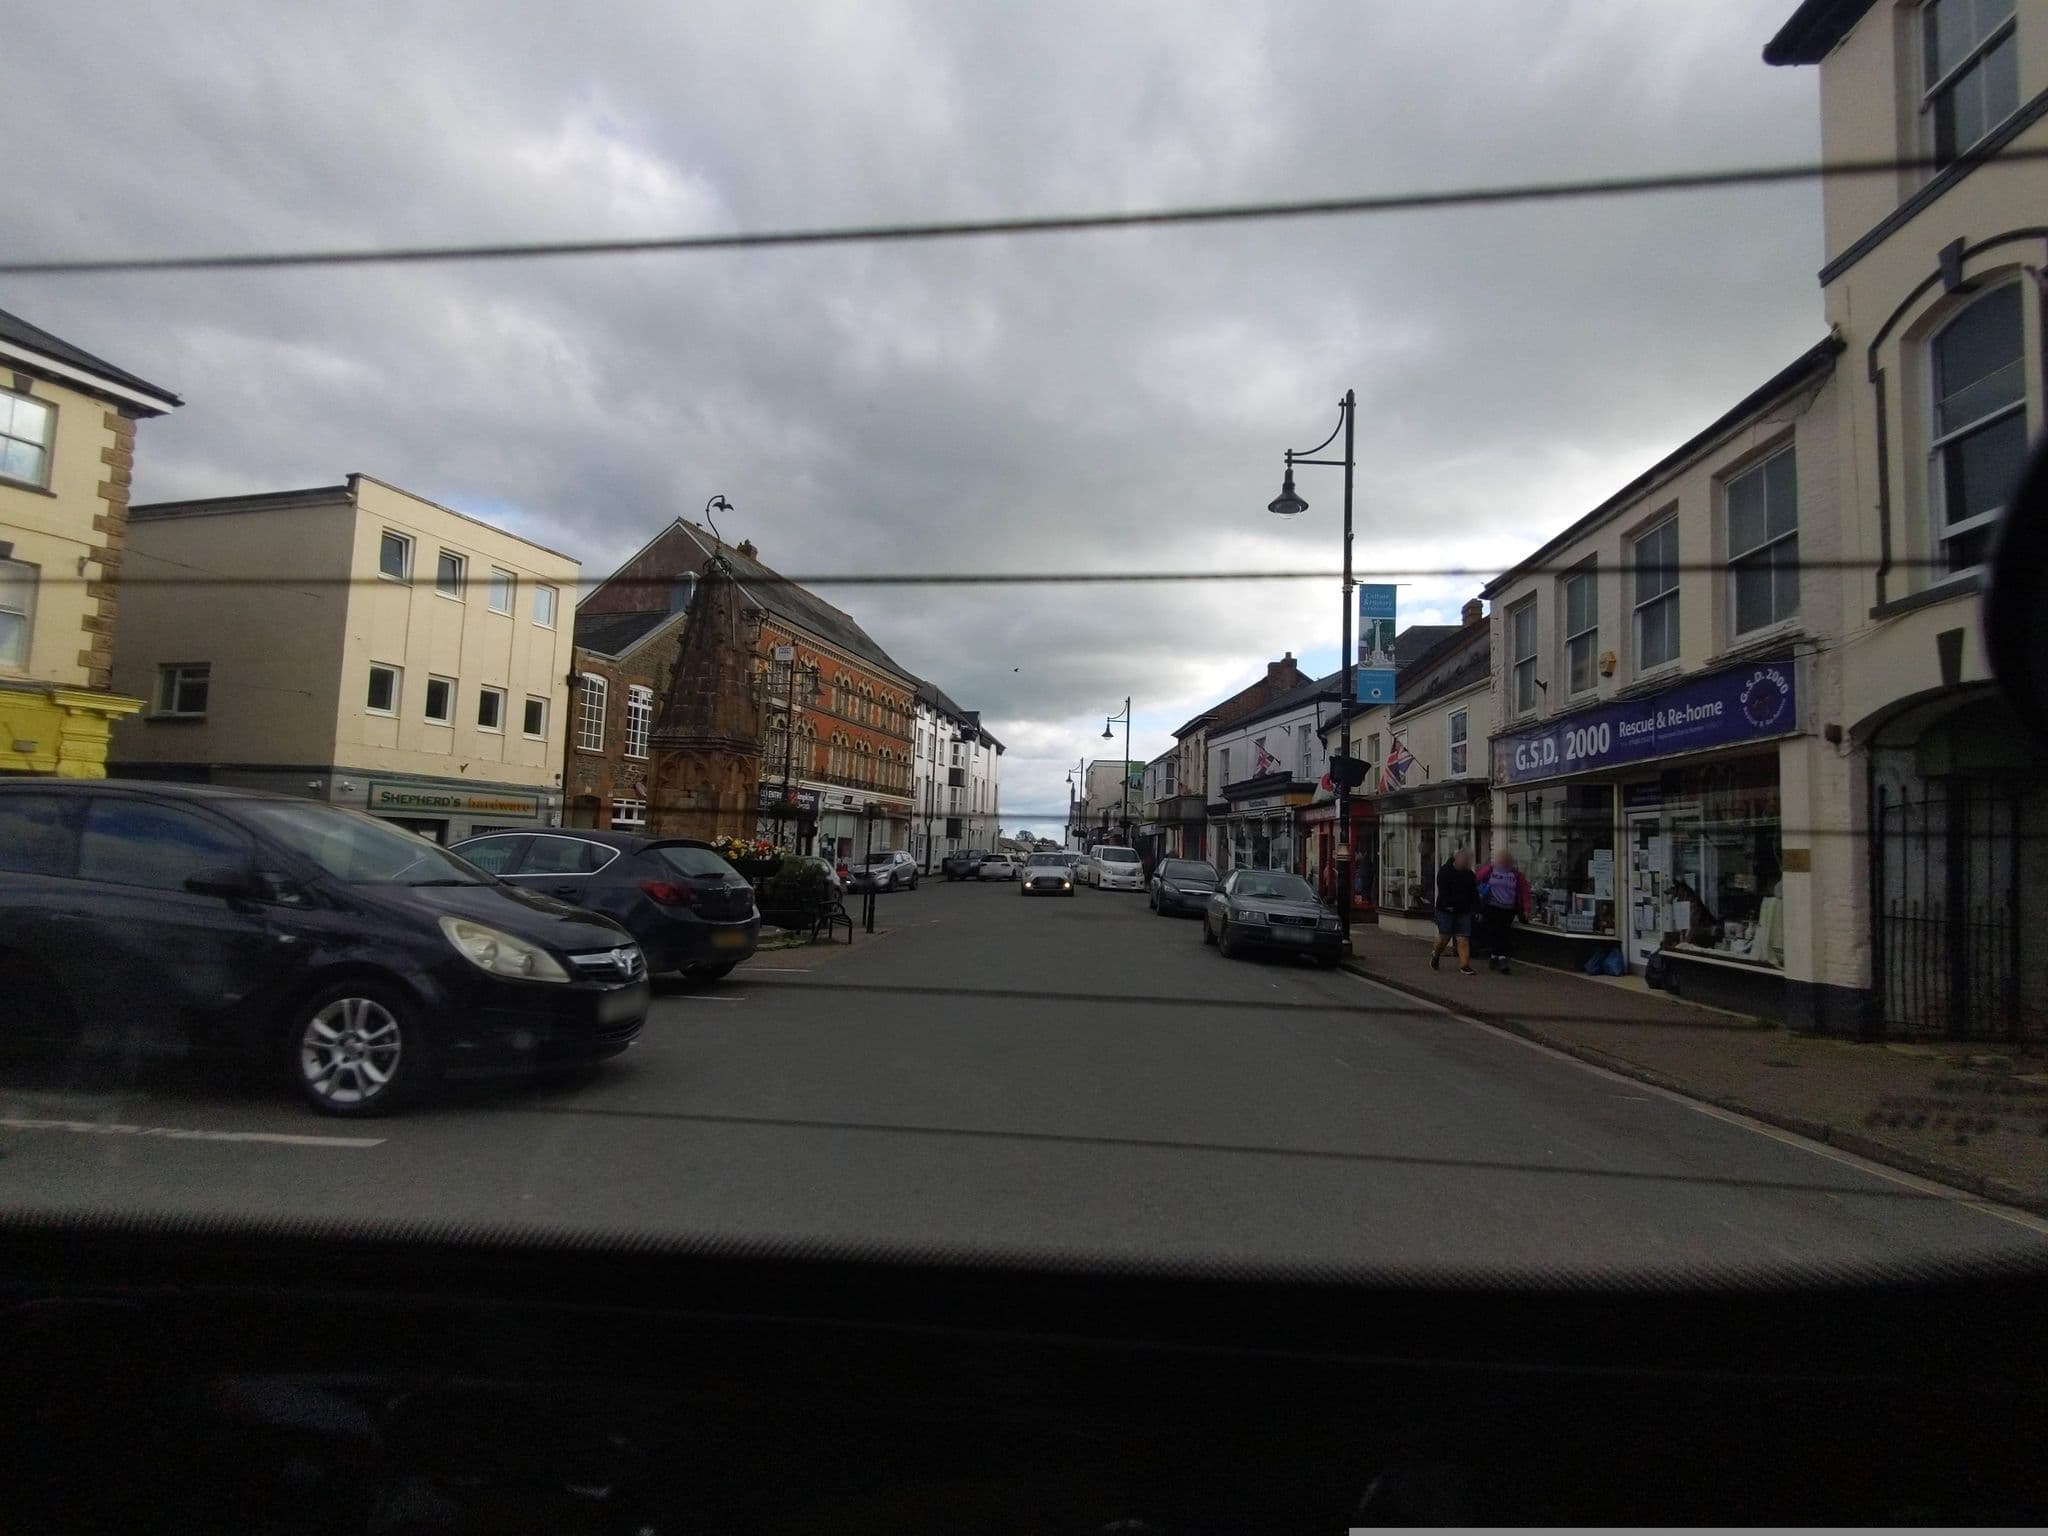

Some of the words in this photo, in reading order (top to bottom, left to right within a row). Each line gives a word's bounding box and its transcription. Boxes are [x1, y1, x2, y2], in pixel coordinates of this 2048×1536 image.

[1766, 668, 1789, 695] 2000
[1619, 716, 1654, 738] Rescue
[1656, 710, 1667, 729] &
[1668, 700, 1723, 727] Re-home
[1515, 737, 1559, 771] G.S.D.
[1566, 722, 1610, 761] 2000
